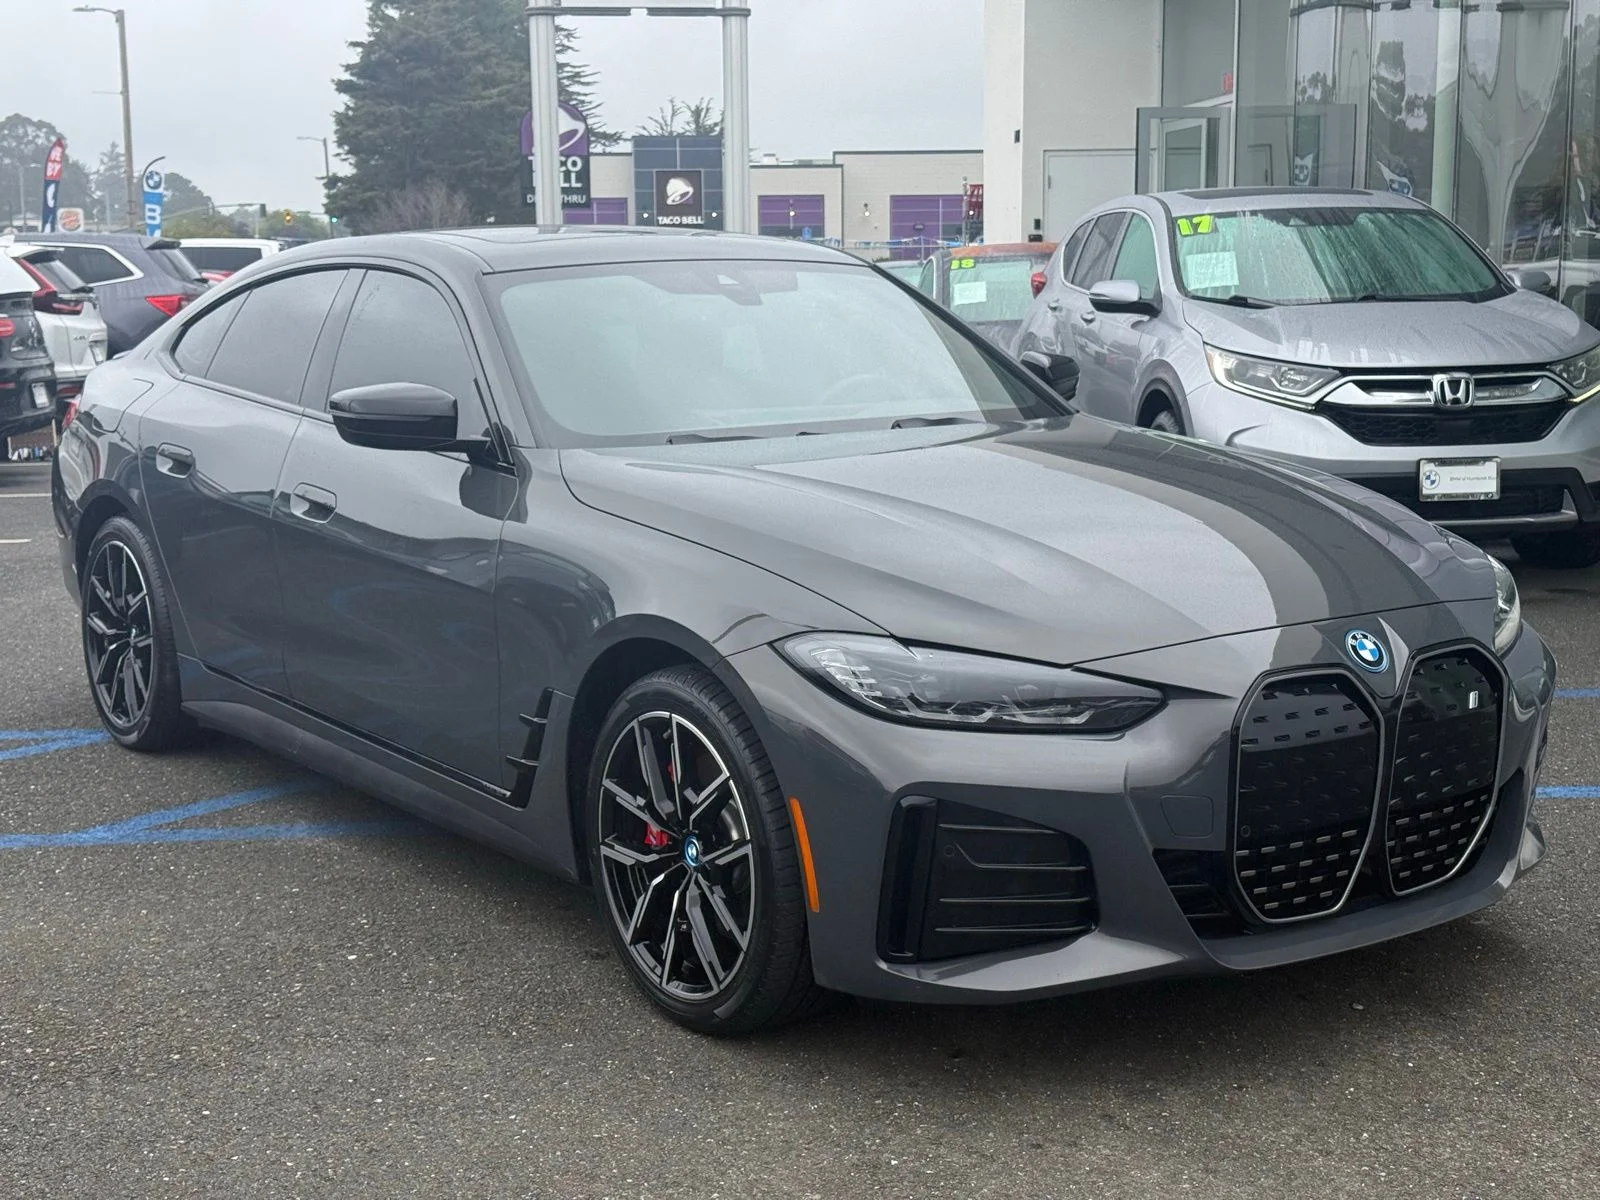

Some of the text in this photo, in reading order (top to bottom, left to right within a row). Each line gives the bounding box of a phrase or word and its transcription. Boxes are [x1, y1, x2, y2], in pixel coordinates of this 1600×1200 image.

[528, 156, 582, 172] TCO
[657, 215, 704, 225] TACO BELL
[1177, 215, 1213, 236] 17
